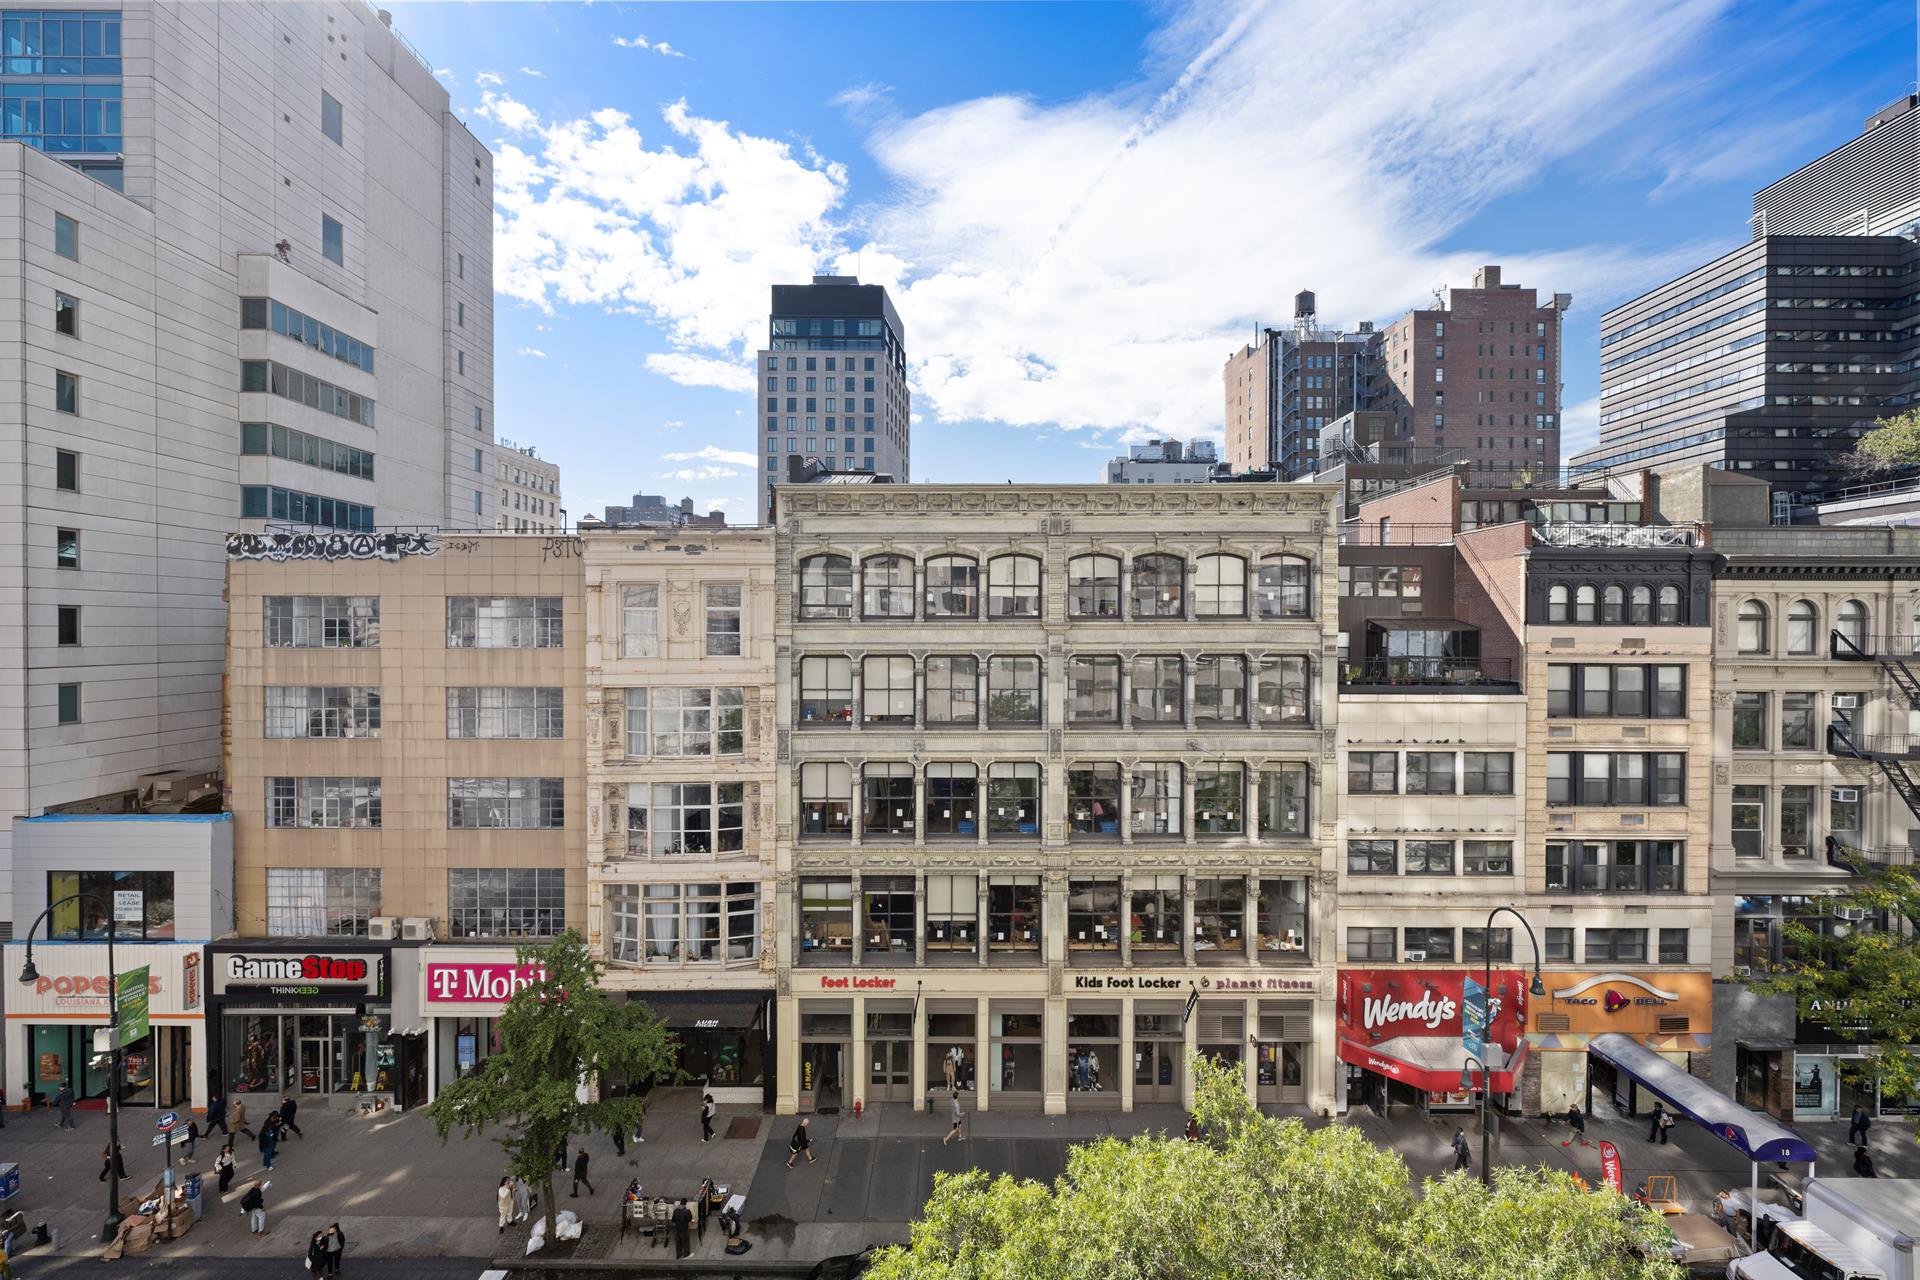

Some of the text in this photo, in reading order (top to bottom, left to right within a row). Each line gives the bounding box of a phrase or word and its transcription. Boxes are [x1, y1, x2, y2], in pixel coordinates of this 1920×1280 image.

[228, 955, 367, 981] GameStop
[464, 969, 547, 999] Mobil
[821, 975, 896, 988] Foot Locker
[1075, 976, 1181, 989] Kids Foot Locker
[1216, 978, 1262, 990] planet
[55, 998, 102, 1006] LOUISIANA
[1565, 997, 1667, 1006] TACO BELL
[1363, 989, 1456, 1029] Wendy's
